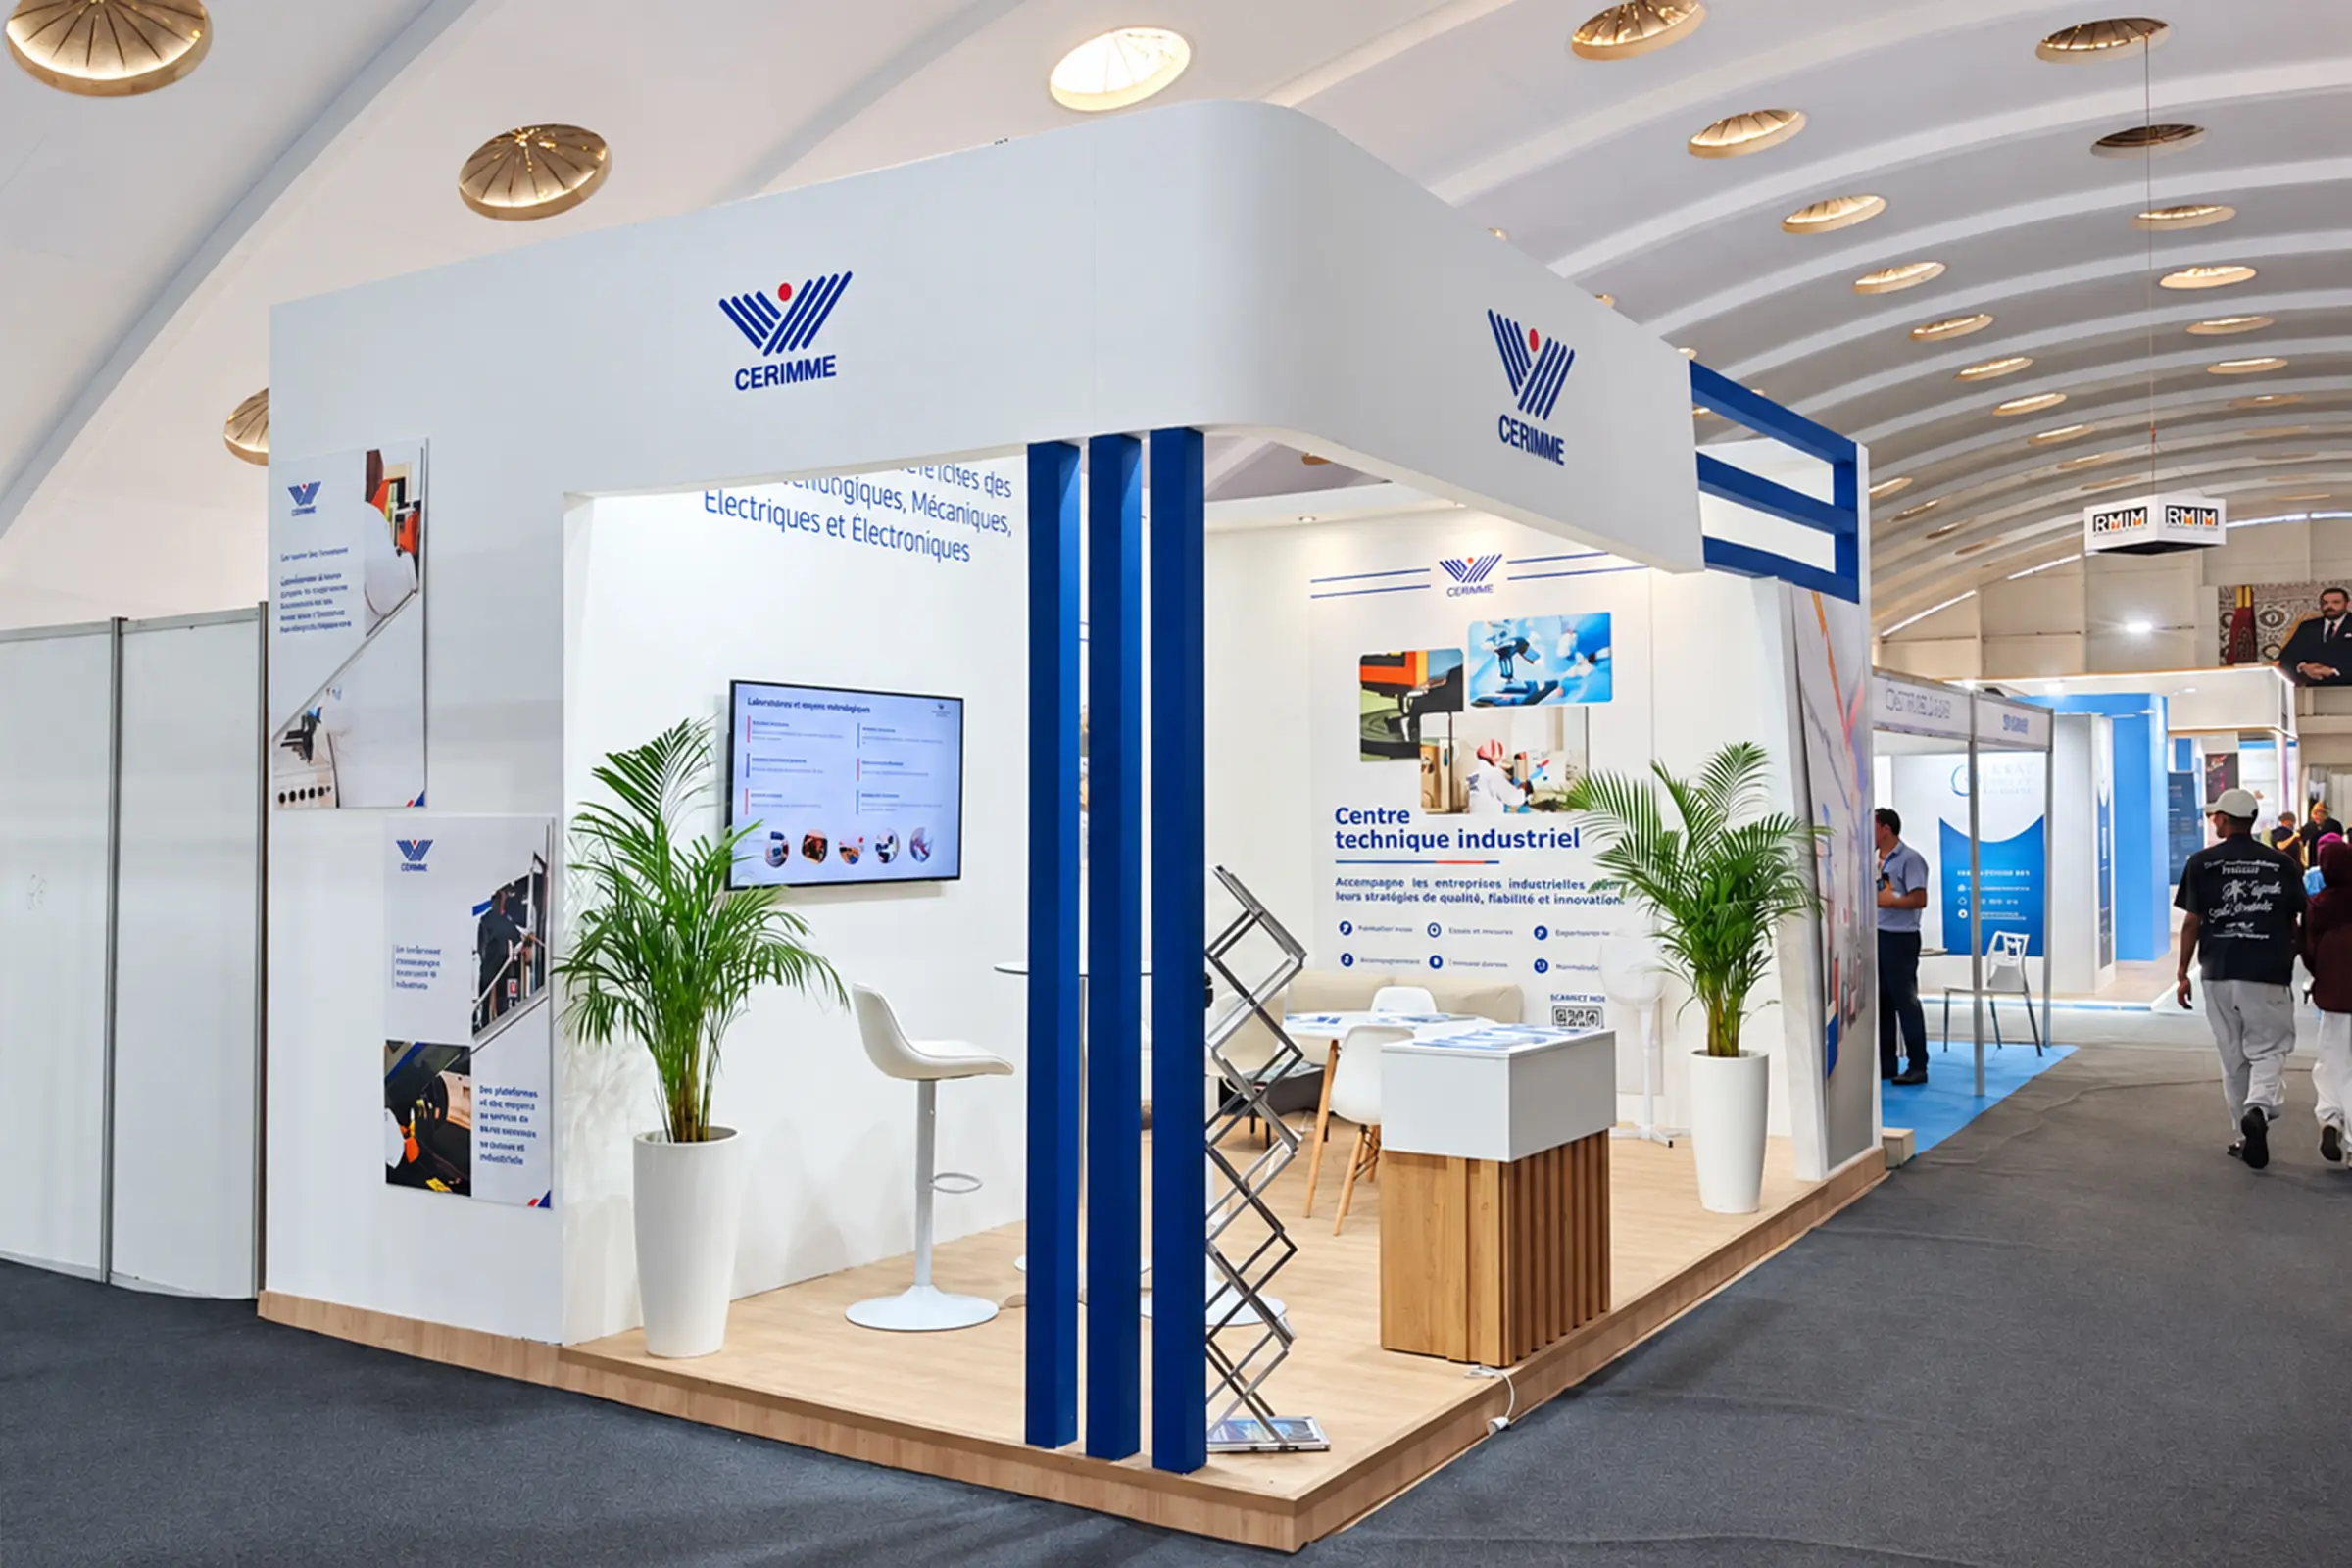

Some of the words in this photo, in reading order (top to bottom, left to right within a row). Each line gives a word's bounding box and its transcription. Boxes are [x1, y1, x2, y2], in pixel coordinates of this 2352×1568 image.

[735, 354, 837, 391] CERIMME
[1498, 414, 1566, 466] CERIMME
[911, 490, 1012, 538] Mécaniques,
[826, 514, 846, 539] et
[852, 512, 971, 563] Électroniques
[1335, 807, 1411, 825] Centre
[1335, 828, 1450, 853] technique
[1458, 826, 1581, 849] industriel
[1335, 891, 1362, 902] leurs
[1365, 891, 1420, 904] stratégies
[1422, 892, 1438, 903] de
[1488, 893, 1535, 905] fiabilité
[1538, 894, 1550, 905] et
[1412, 878, 1429, 888] les
[1435, 878, 1502, 890] entreprises
[1509, 878, 1586, 890] industrielles
